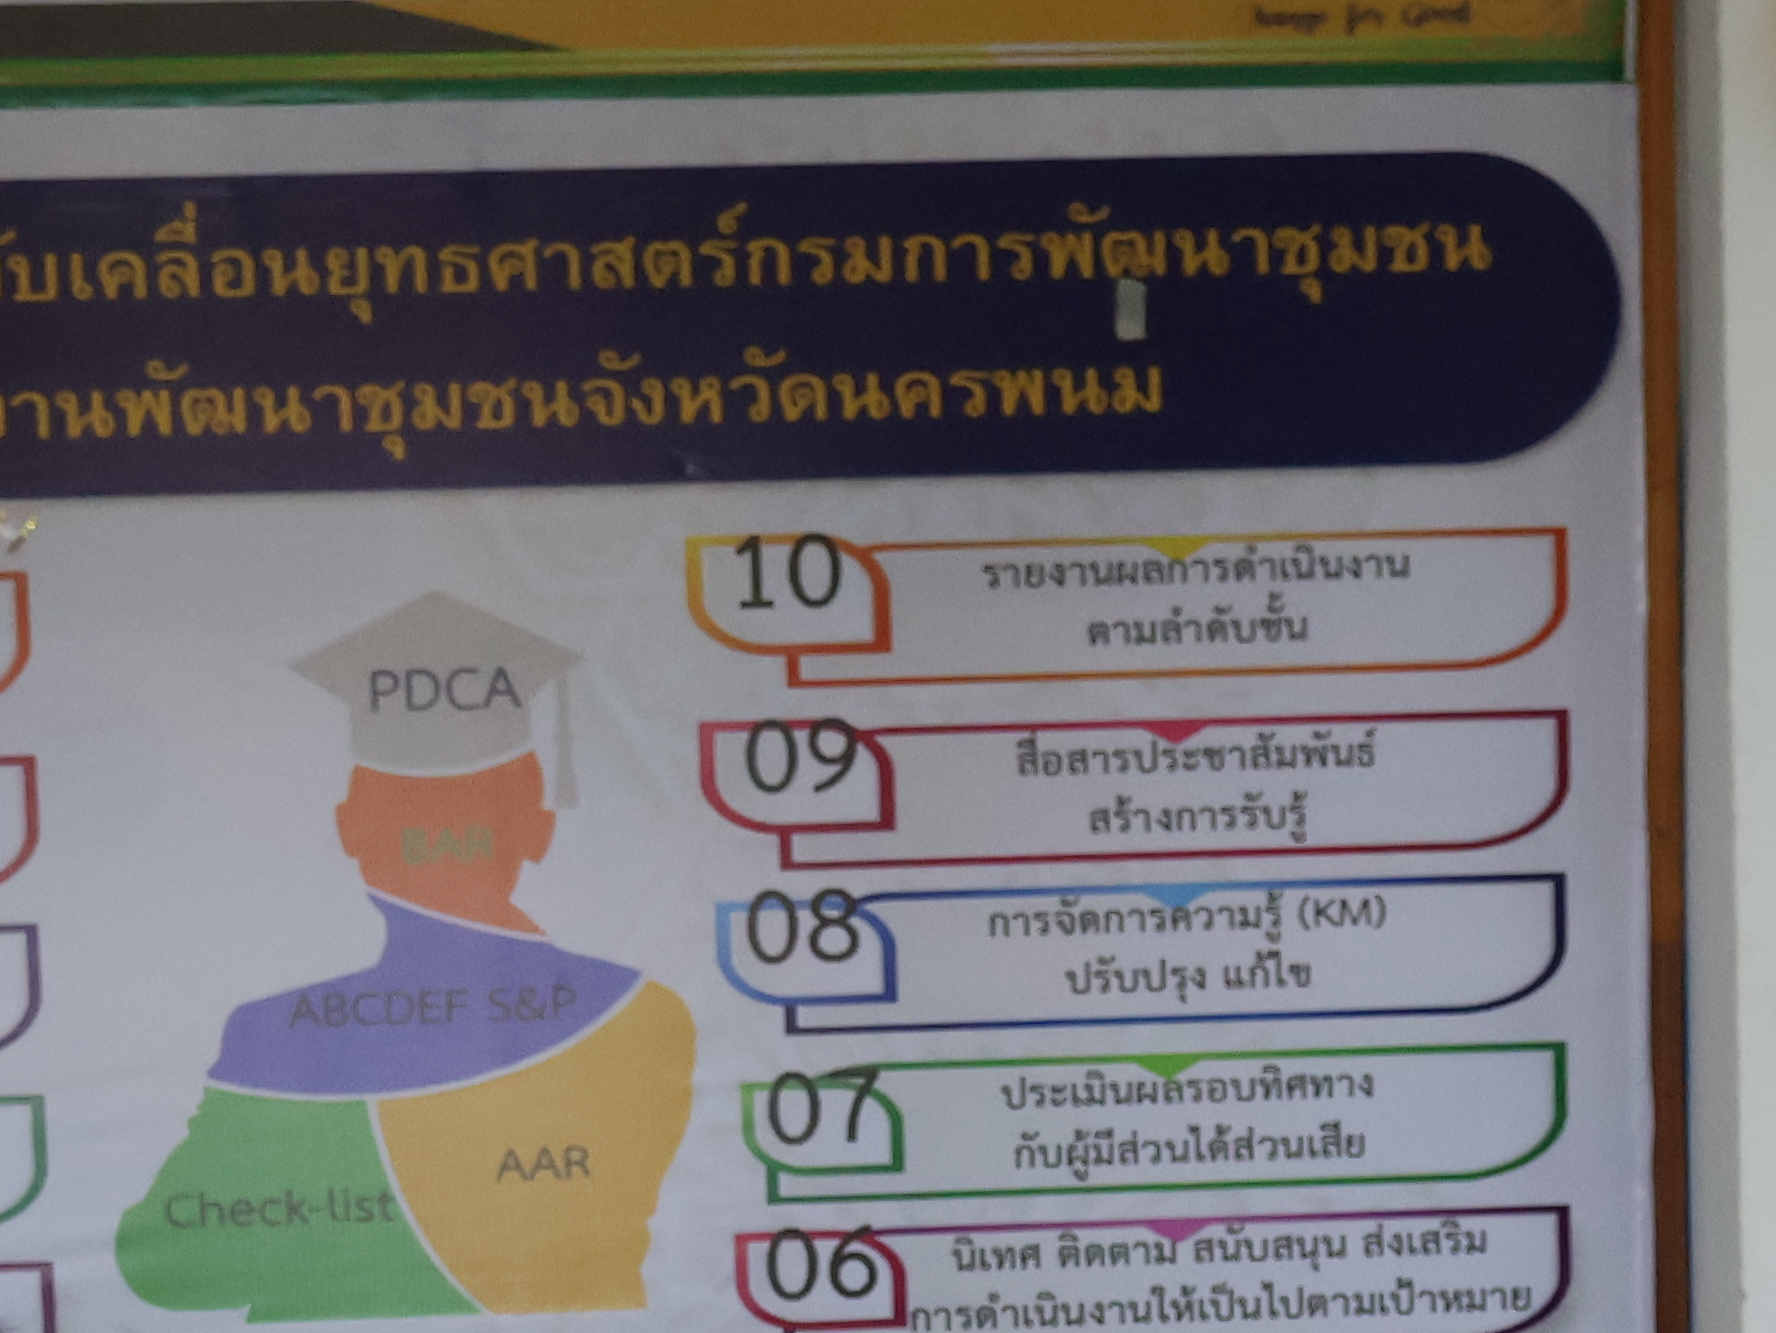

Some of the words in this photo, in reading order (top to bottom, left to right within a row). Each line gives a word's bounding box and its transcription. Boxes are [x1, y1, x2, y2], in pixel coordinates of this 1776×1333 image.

[734, 533, 844, 610] 10
[981, 546, 1411, 593] รายงานผลการดำเนินงาน
[1086, 592, 1310, 648] ตามลำดับชั้น
[368, 665, 523, 714] PDCA
[743, 715, 859, 796] 09
[1015, 728, 1378, 777] สื่อสารประชาสัมพันธ์
[400, 824, 495, 865] BAR
[1088, 789, 1310, 844] สร้างการรับรู้
[744, 887, 861, 967] 08
[987, 889, 1284, 947] การจัดการความรู้
[1296, 895, 1387, 931] (KM)
[1065, 957, 1207, 1003] ปรับปรุง
[1222, 947, 1314, 992] แก้ไข
[288, 986, 468, 1031] ABCDEF
[485, 982, 578, 1023] S&P
[765, 1067, 879, 1147] 07
[1000, 1070, 1376, 1112] ประเมินผลรอบทิศทาง
[495, 1145, 592, 1184] AAR
[1012, 1121, 1367, 1185] กับผู้มีส่วนได้ส่วนเสีย
[163, 1188, 398, 1230] Check-list
[765, 1224, 879, 1305] 06
[951, 1232, 1042, 1275] นิเทศ
[1056, 1229, 1177, 1269] ติดตาม
[1193, 1222, 1349, 1273] สนับสนุน
[1362, 1217, 1489, 1260] ส่งเสริม
